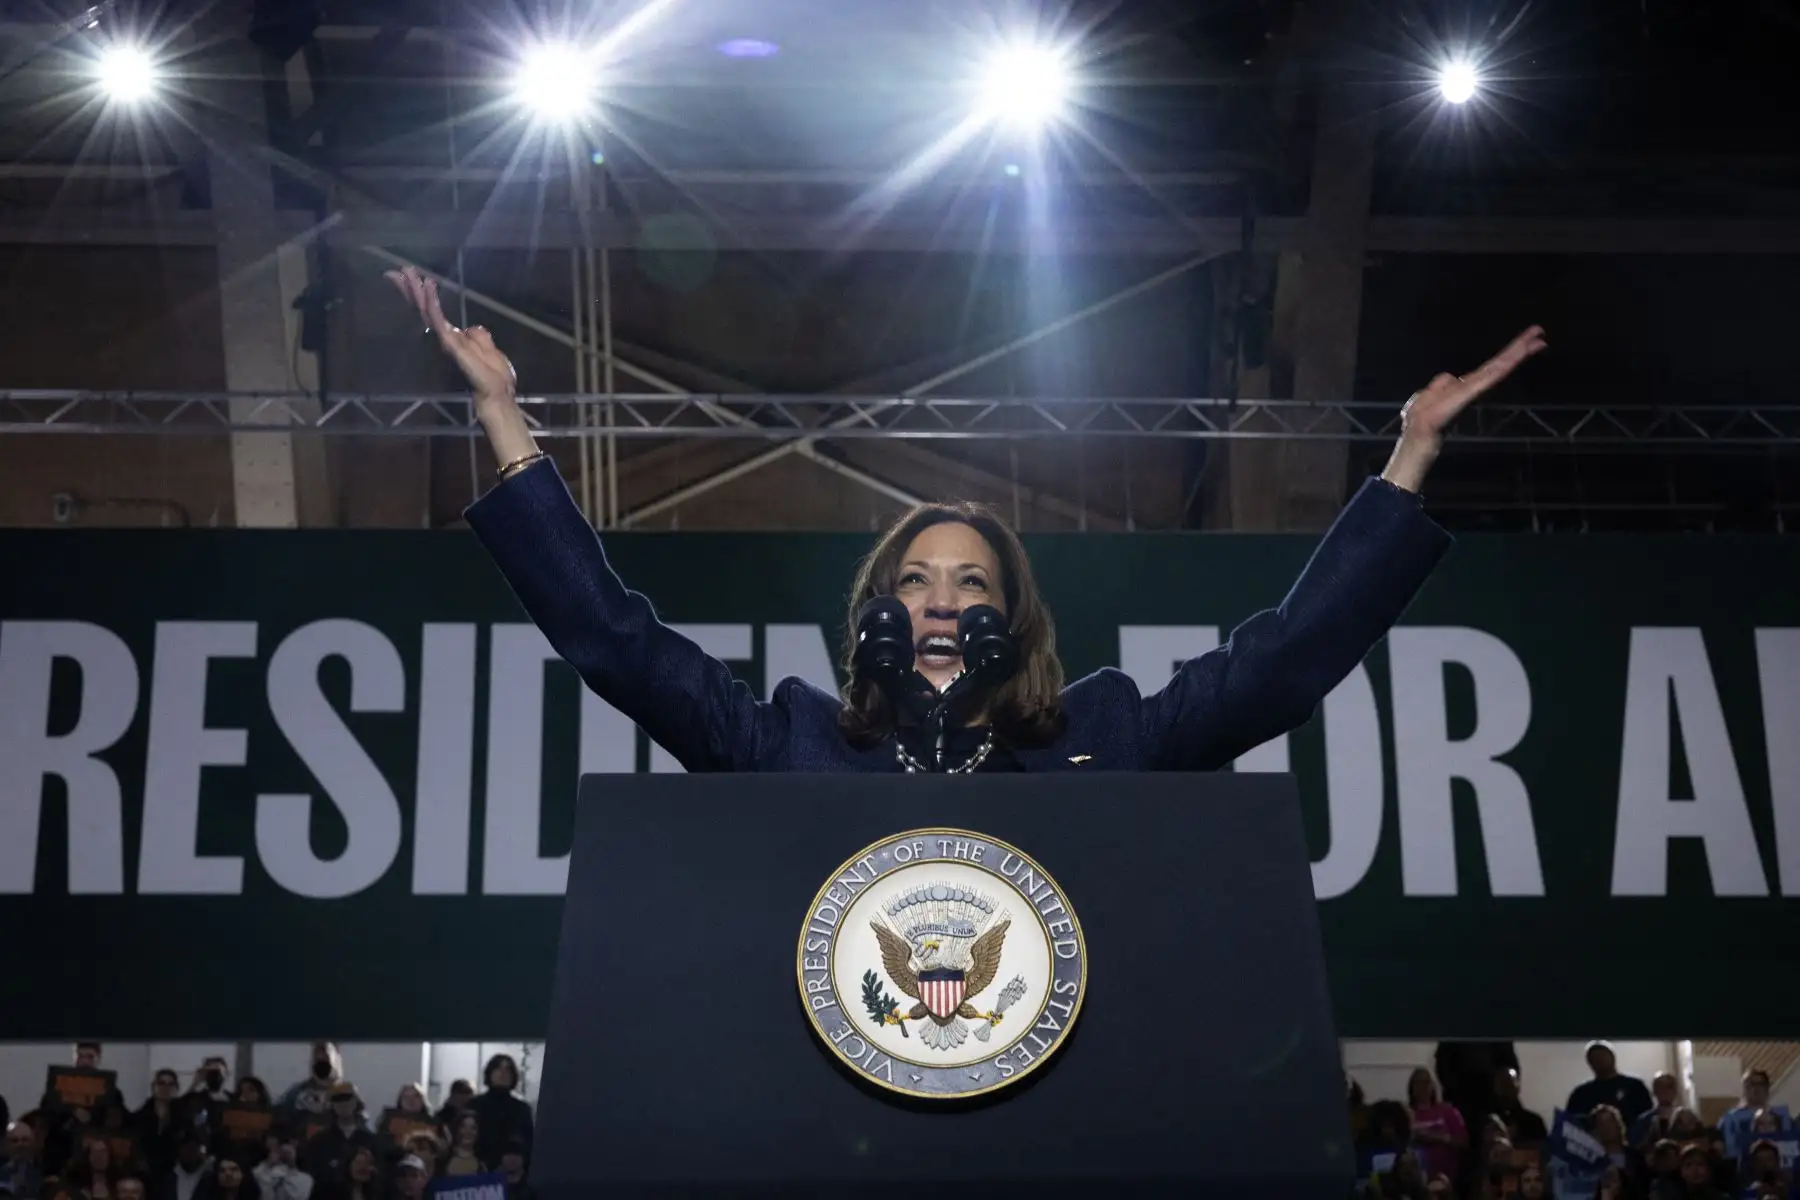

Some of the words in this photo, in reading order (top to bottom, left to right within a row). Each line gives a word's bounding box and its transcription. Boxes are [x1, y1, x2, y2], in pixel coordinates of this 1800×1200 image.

[894, 841, 924, 863] OF
[937, 839, 986, 863] THE
[804, 854, 879, 1012] PRESIDENT
[952, 927, 975, 935] UNUM
[1001, 853, 1079, 960] UNITED
[829, 1021, 894, 1083] VICE
[994, 979, 1077, 1078] STATES
